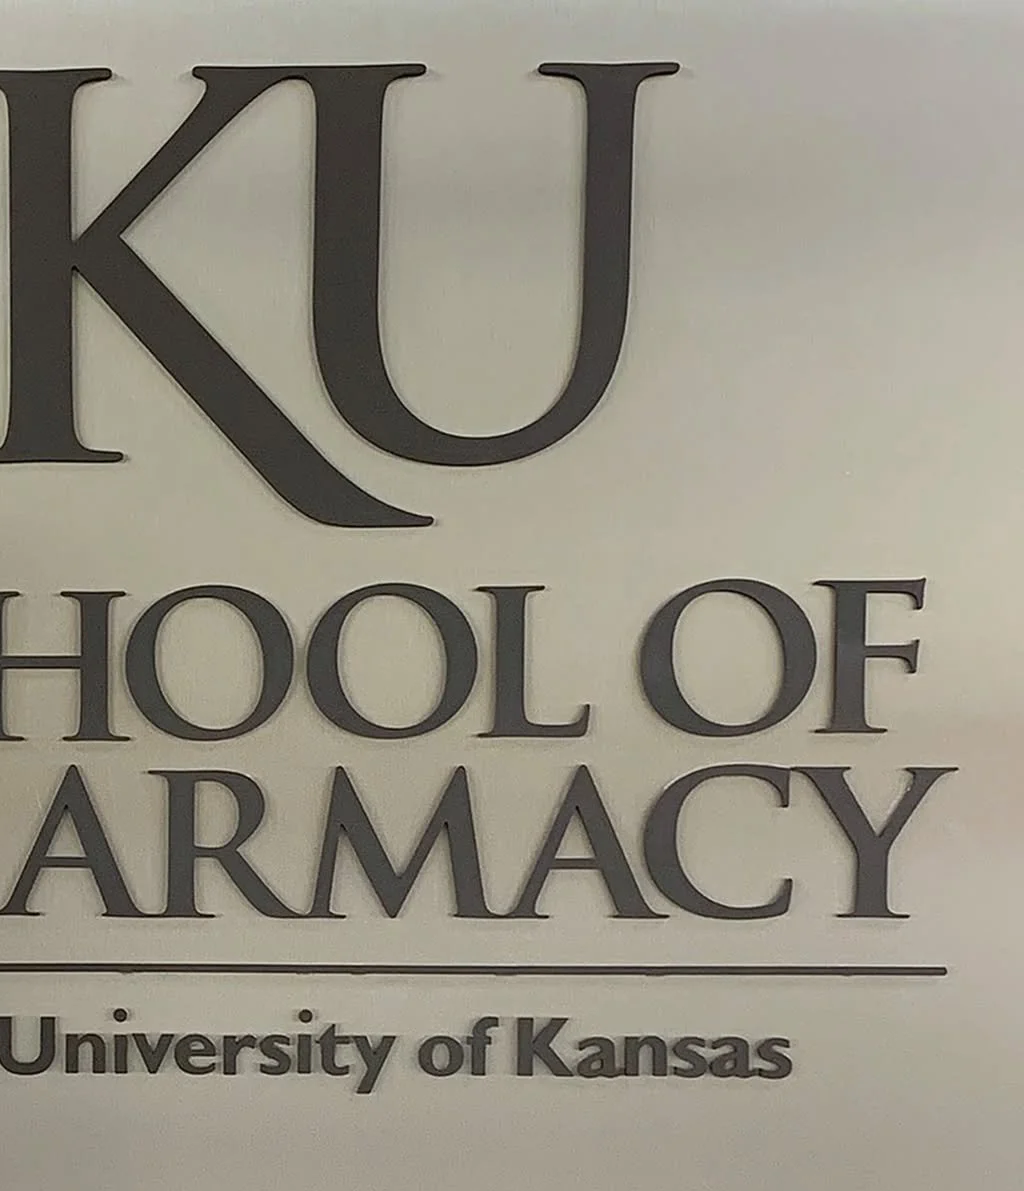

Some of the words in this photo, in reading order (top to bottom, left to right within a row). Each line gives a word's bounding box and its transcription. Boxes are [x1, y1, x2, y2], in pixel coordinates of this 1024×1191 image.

[637, 577, 927, 738] OF
[417, 1015, 501, 1079] of
[517, 1017, 793, 1080] Kansas
